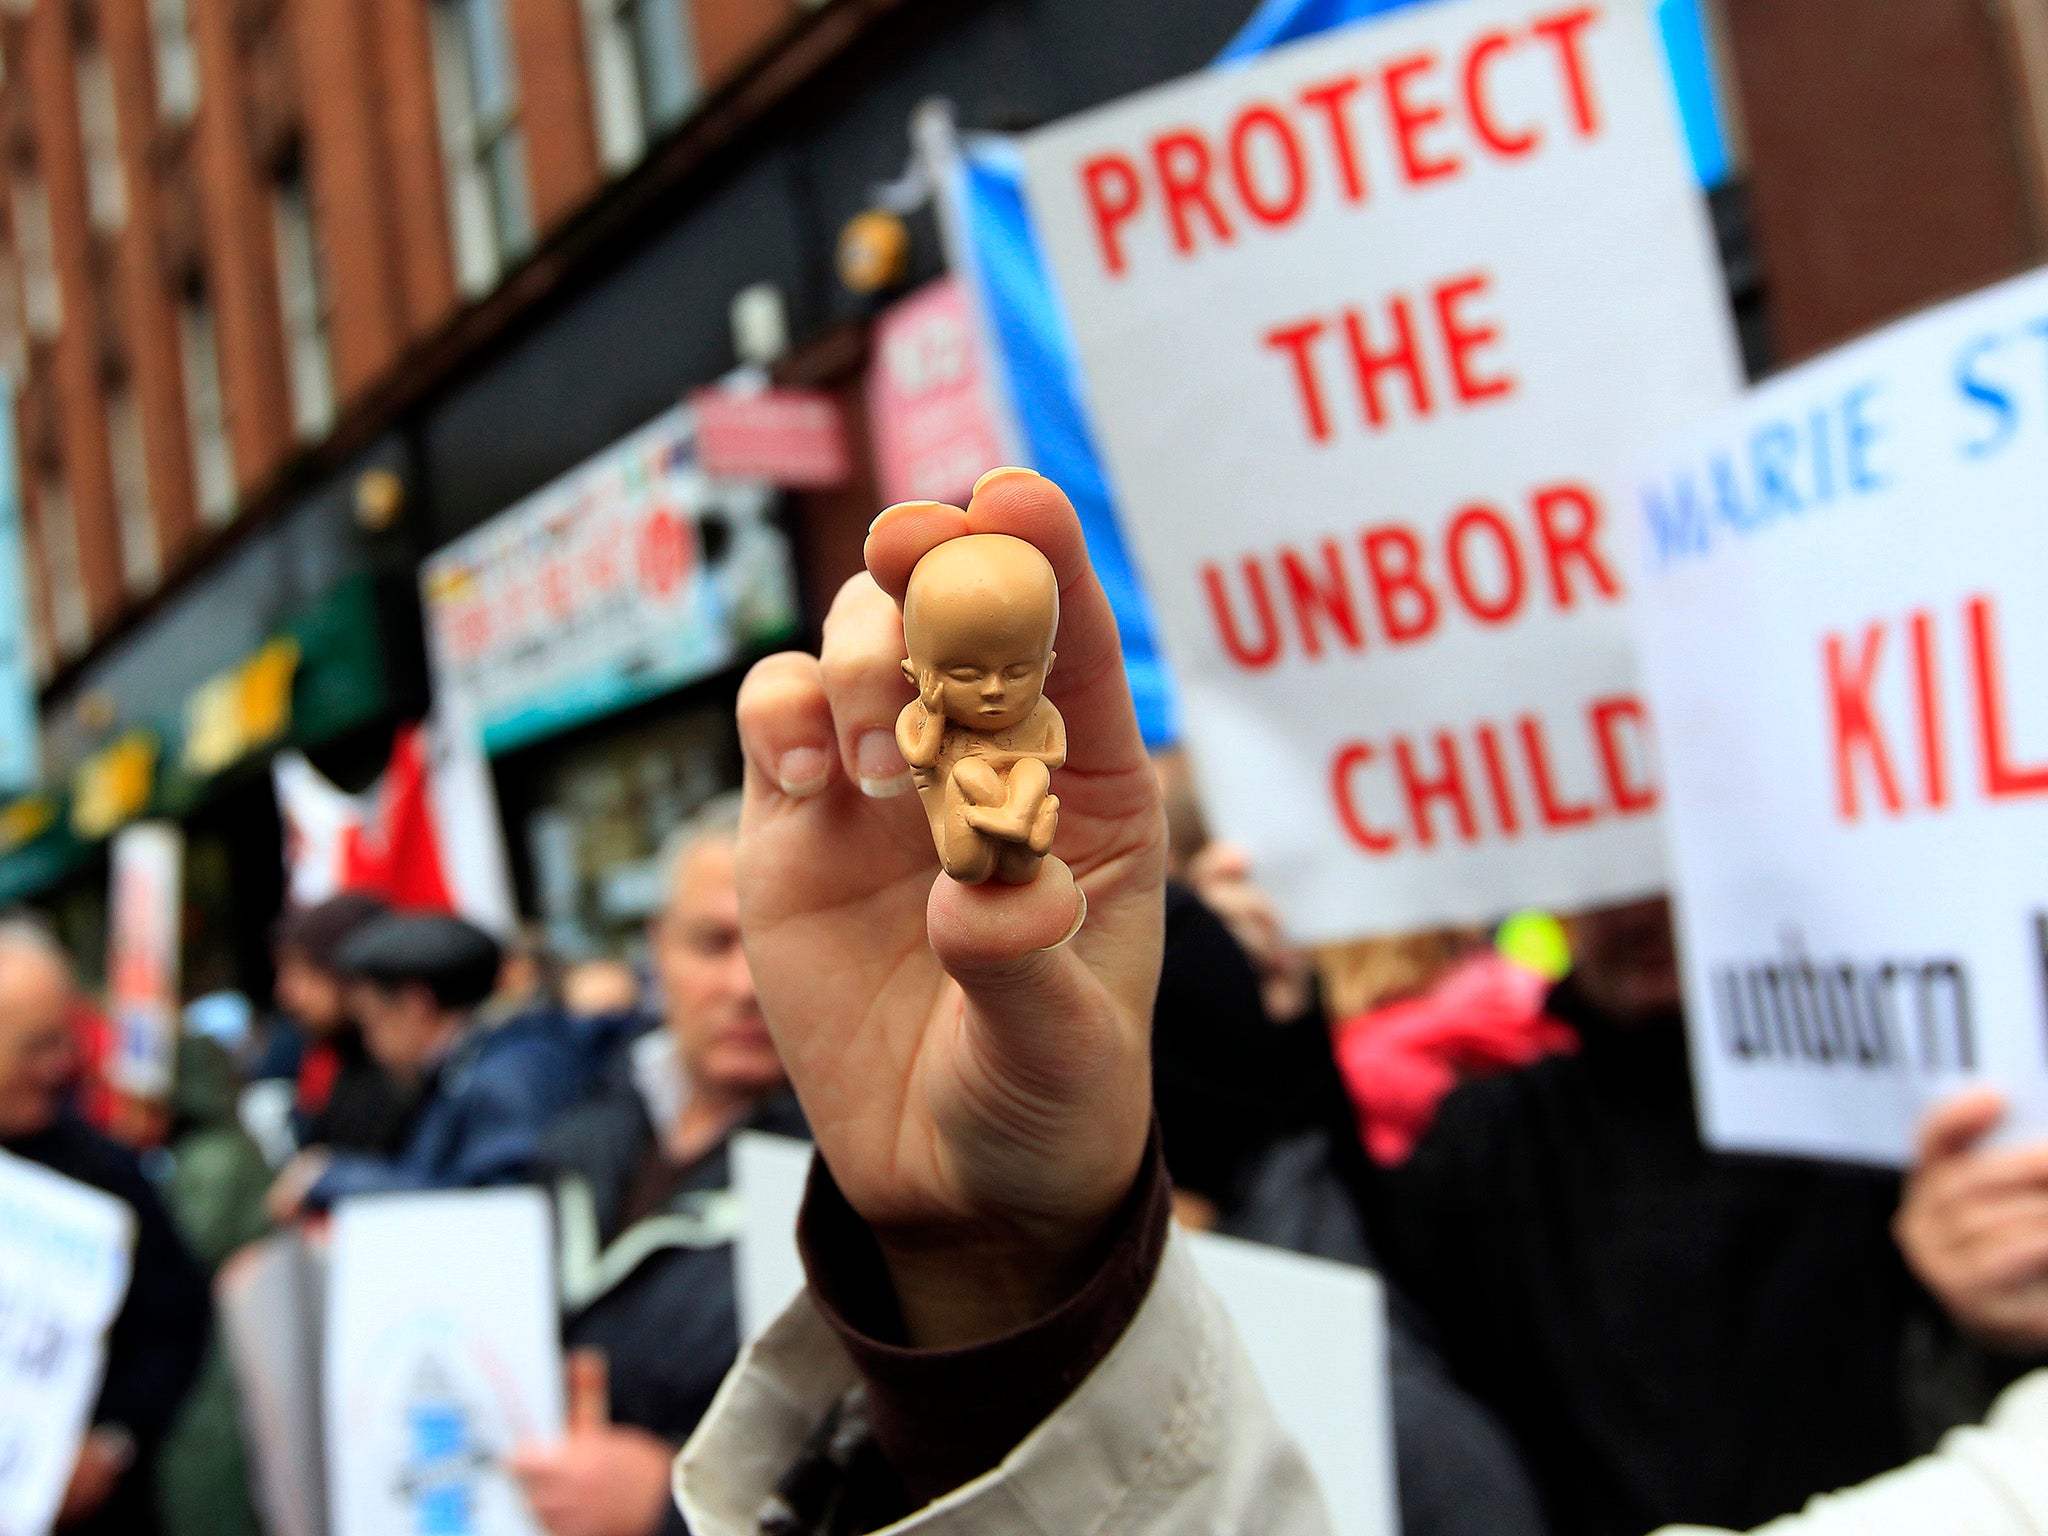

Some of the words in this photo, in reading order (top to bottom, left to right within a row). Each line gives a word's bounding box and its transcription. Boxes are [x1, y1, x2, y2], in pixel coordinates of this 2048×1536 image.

[1079, 8, 1603, 278] PROTECT
[1263, 271, 1515, 442] THE
[1638, 377, 1888, 568] MARIE
[1200, 481, 1620, 671] UNBOR
[1712, 925, 1978, 1075] unborn
